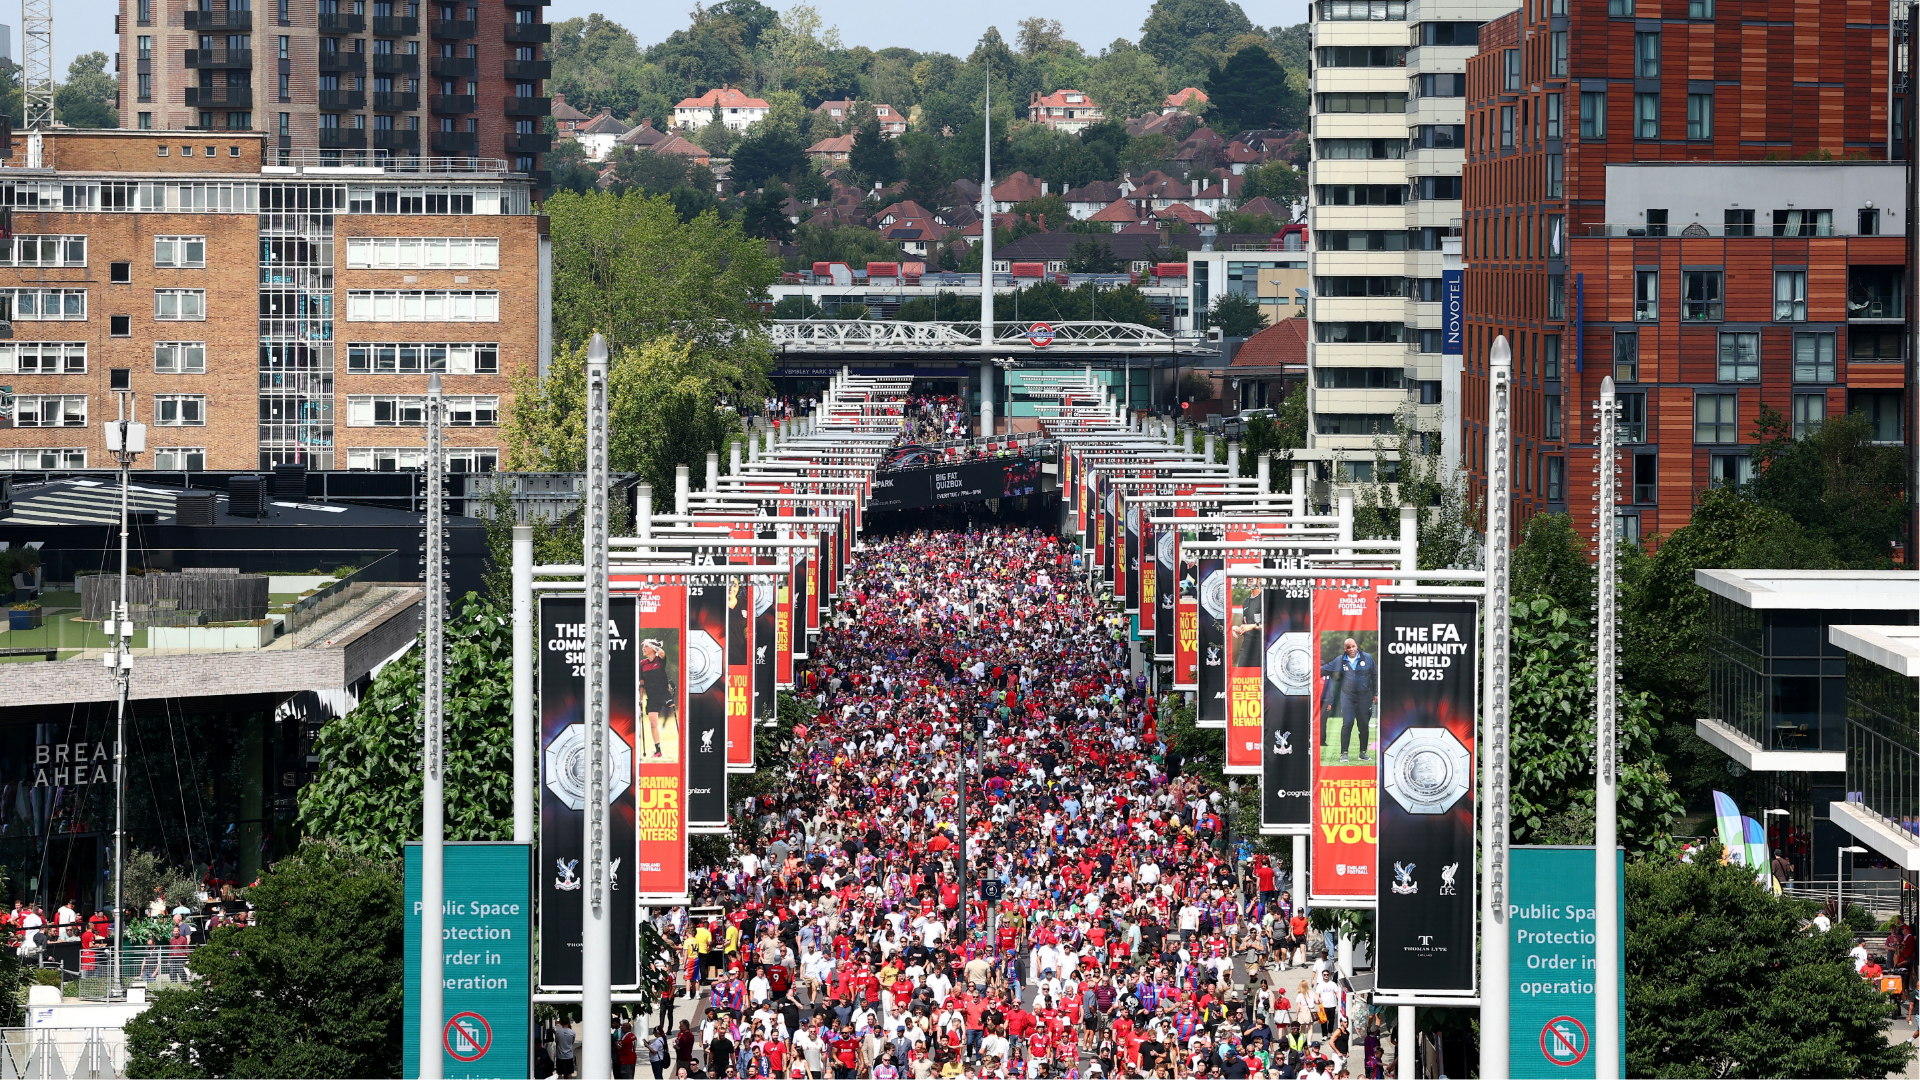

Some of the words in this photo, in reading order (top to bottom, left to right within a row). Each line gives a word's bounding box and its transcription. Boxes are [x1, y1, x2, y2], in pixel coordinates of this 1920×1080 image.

[1448, 275, 1460, 343] NOVOTEL
[772, 324, 851, 345] BLEY
[870, 324, 955, 345] PARK
[935, 473, 946, 481] BIG
[947, 472, 958, 480] FAT
[935, 480, 963, 490] QUIZBOX
[1274, 559, 1297, 569] THE
[1286, 590, 1309, 599] 2025
[1395, 627, 1429, 641] THE
[1432, 624, 1460, 641] FA
[1388, 643, 1467, 654] COMMUNITY
[1405, 656, 1451, 667] SHIELD
[734, 675, 747, 687] YOU
[1411, 669, 1444, 680] 2025
[728, 687, 747, 701] LL
[736, 702, 747, 716] DO
[1232, 700, 1261, 718] MO
[1232, 718, 1262, 727] REWAR
[36, 741, 127, 764] BREAD
[34, 764, 127, 787] AHEAD
[639, 789, 678, 808] UR
[688, 787, 711, 795] gnizant
[1320, 788, 1336, 807] NO
[1339, 788, 1377, 807] GAM
[639, 809, 678, 828] SROOTS
[1320, 807, 1377, 825] WITHOU
[640, 828, 678, 842] NTEERS
[1320, 824, 1377, 844] YOU
[470, 901, 520, 918] Space
[1509, 904, 1560, 919] Public
[1565, 904, 1596, 922] Spa
[443, 925, 511, 940] otection
[1517, 929, 1595, 944] Protectio
[443, 950, 481, 964] rder
[486, 950, 501, 964] in
[1527, 954, 1577, 969] Order
[443, 975, 508, 989] eration
[772, 973, 780, 983] 9
[1520, 979, 1596, 996] operatio
